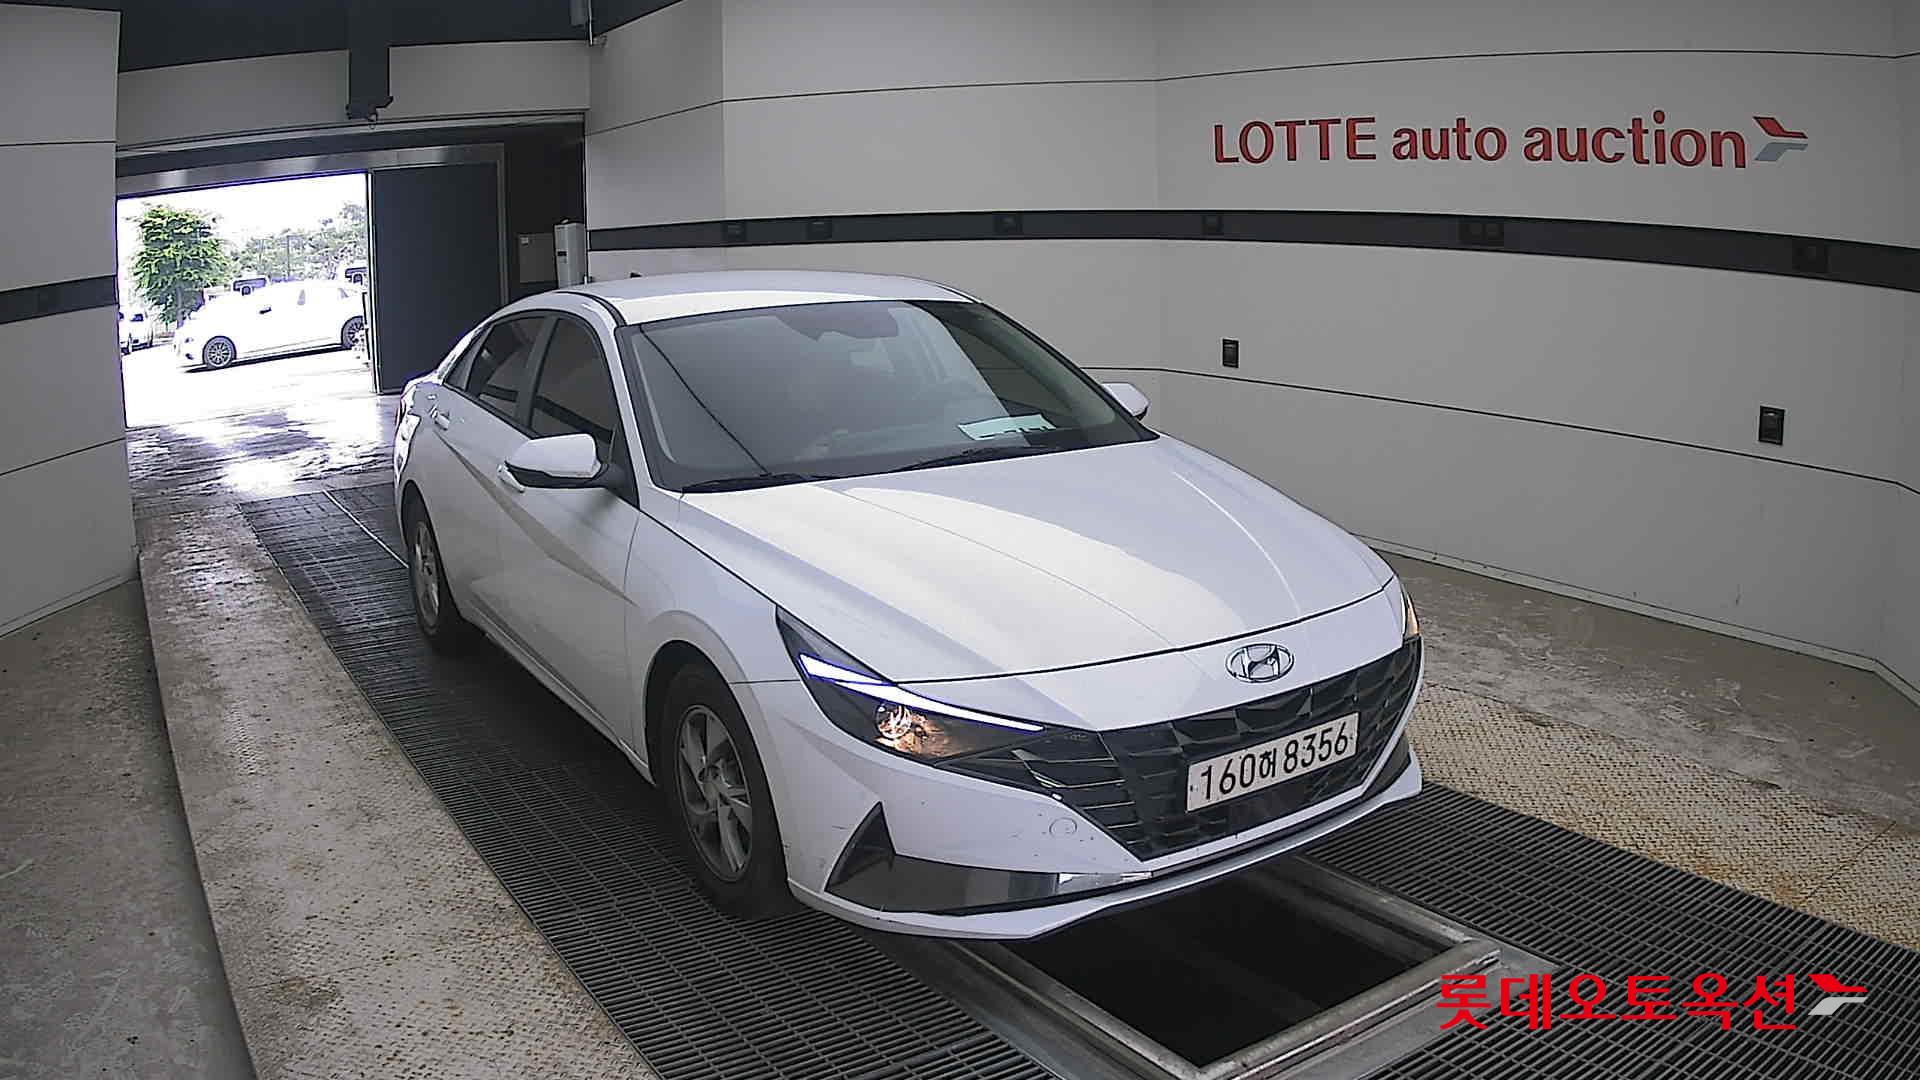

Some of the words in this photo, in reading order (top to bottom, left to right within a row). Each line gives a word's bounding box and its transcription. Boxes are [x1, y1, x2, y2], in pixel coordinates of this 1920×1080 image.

[1214, 117, 1376, 164] LOTTE
[1391, 117, 1507, 162] auto
[1523, 110, 1746, 168] auction
